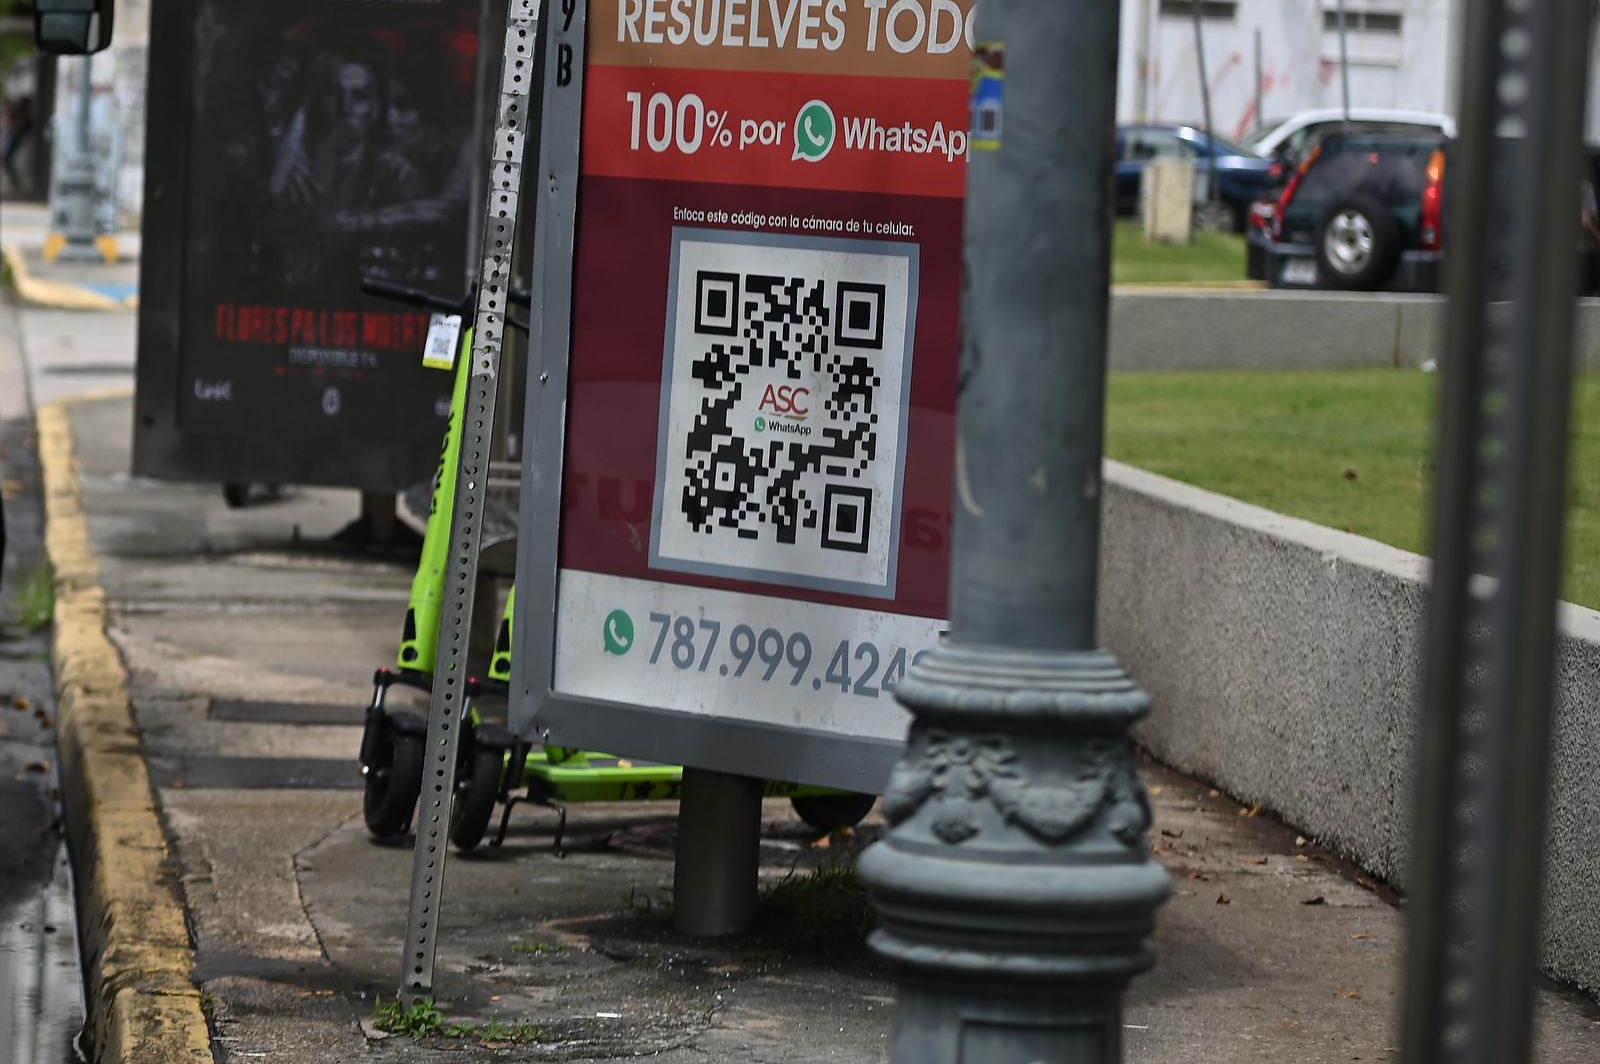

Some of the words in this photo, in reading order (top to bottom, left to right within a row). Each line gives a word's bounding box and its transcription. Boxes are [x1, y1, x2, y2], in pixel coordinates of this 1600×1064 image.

[626, 91, 733, 155] 100%
[739, 117, 786, 148] por
[673, 206, 705, 222] Enfoca
[707, 210, 728, 223] este
[731, 211, 766, 229] código
[768, 216, 787, 228] con
[789, 213, 800, 228] la
[802, 214, 843, 232] cámara
[846, 218, 860, 233] de
[863, 221, 873, 233] tu
[875, 221, 915, 236] celular.
[216, 304, 288, 344] FLORES
[758, 383, 810, 416] ASC
[767, 419, 813, 437] WhatsApp
[647, 611, 934, 700] 787.999.424
